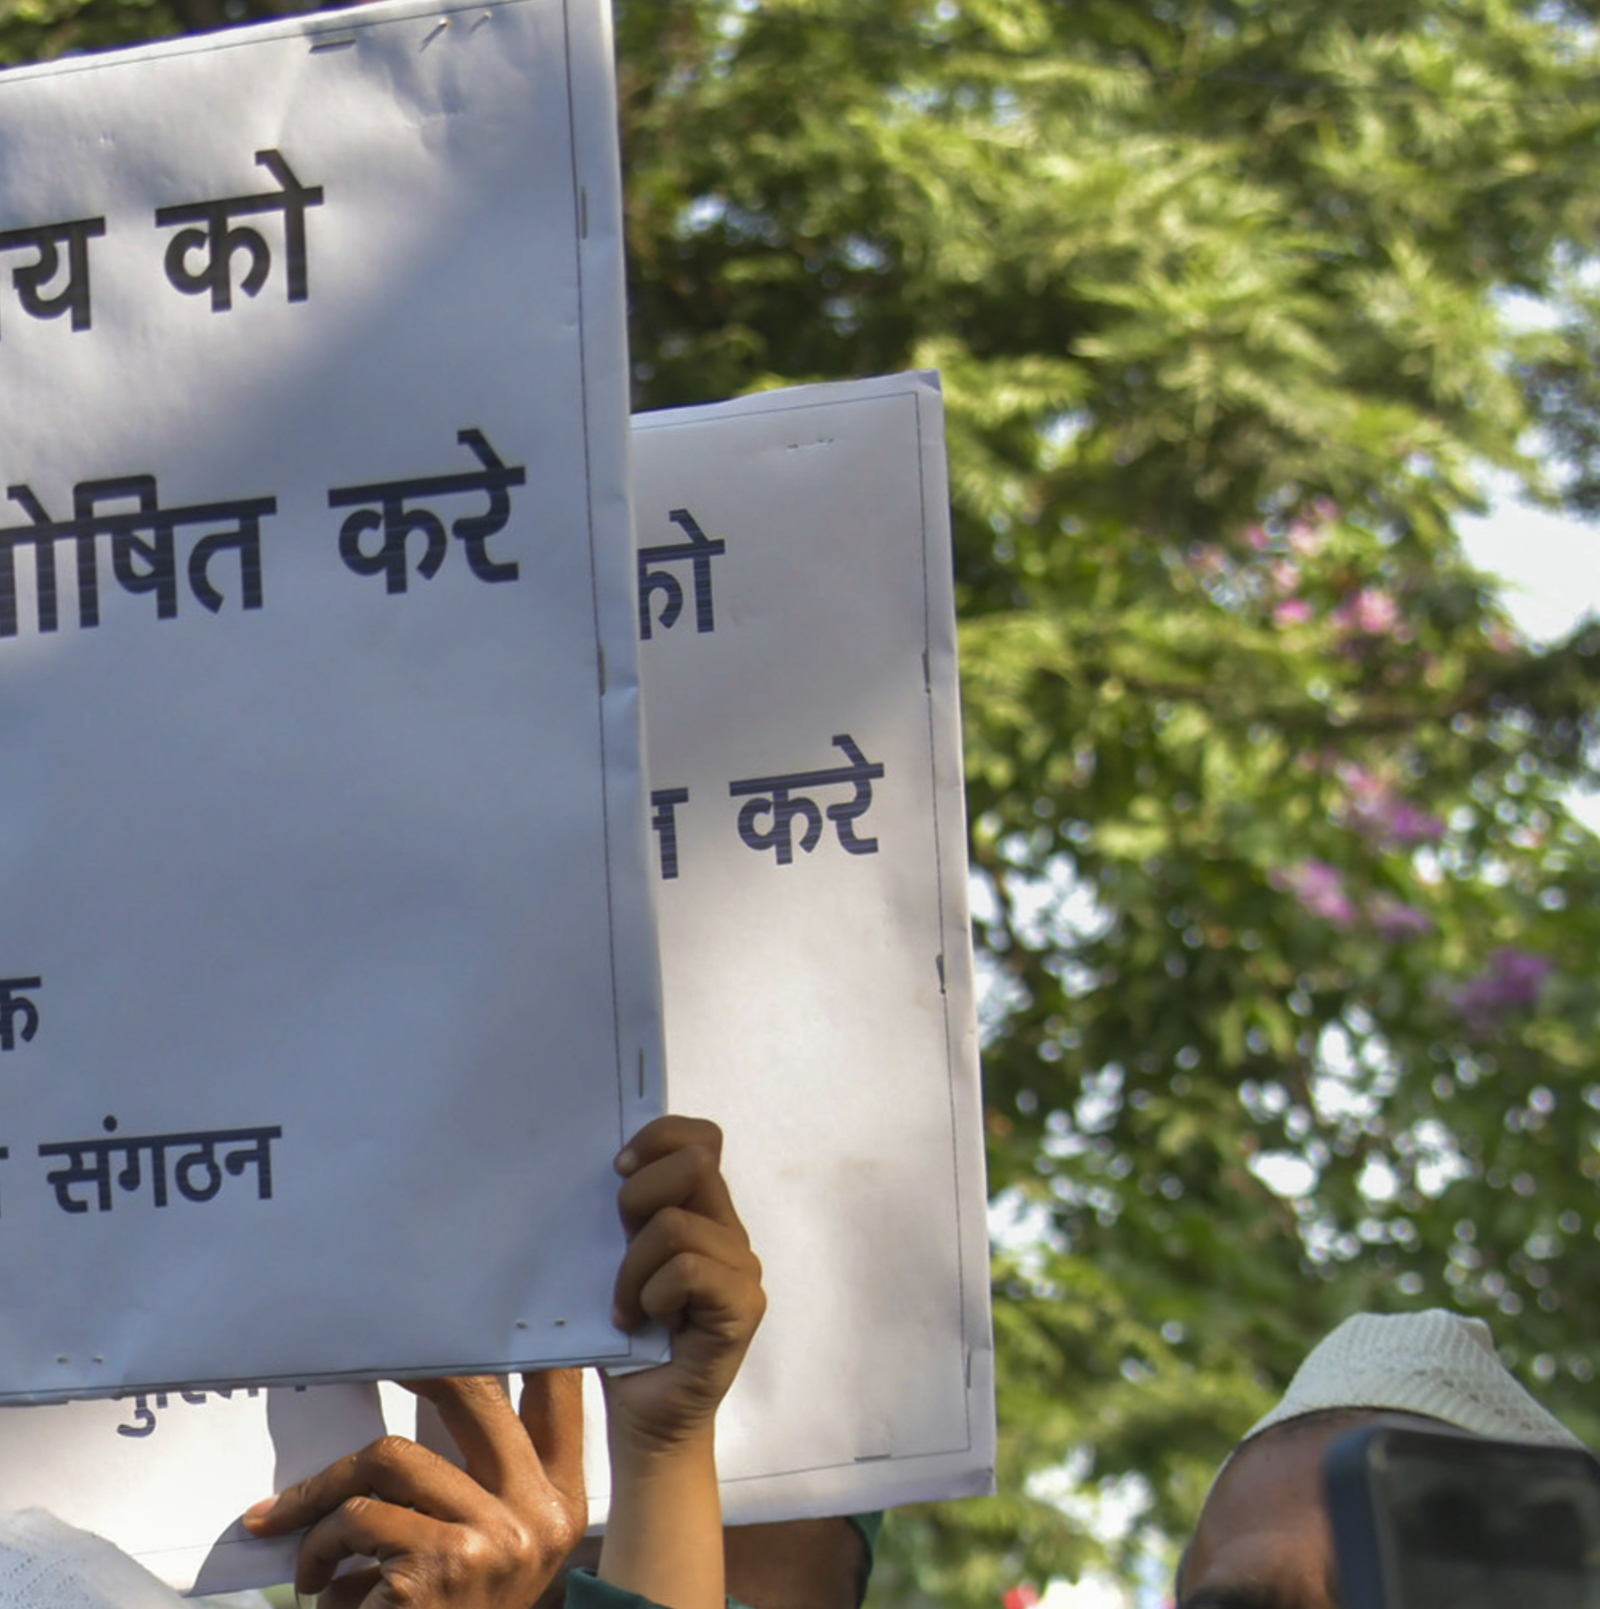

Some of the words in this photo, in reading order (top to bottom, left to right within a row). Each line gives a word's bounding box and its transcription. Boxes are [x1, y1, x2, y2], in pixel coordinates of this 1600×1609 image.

[155, 148, 325, 313] को
[328, 429, 525, 594] करे
[729, 734, 884, 865] करे
[39, 1116, 282, 1213] संगठन
